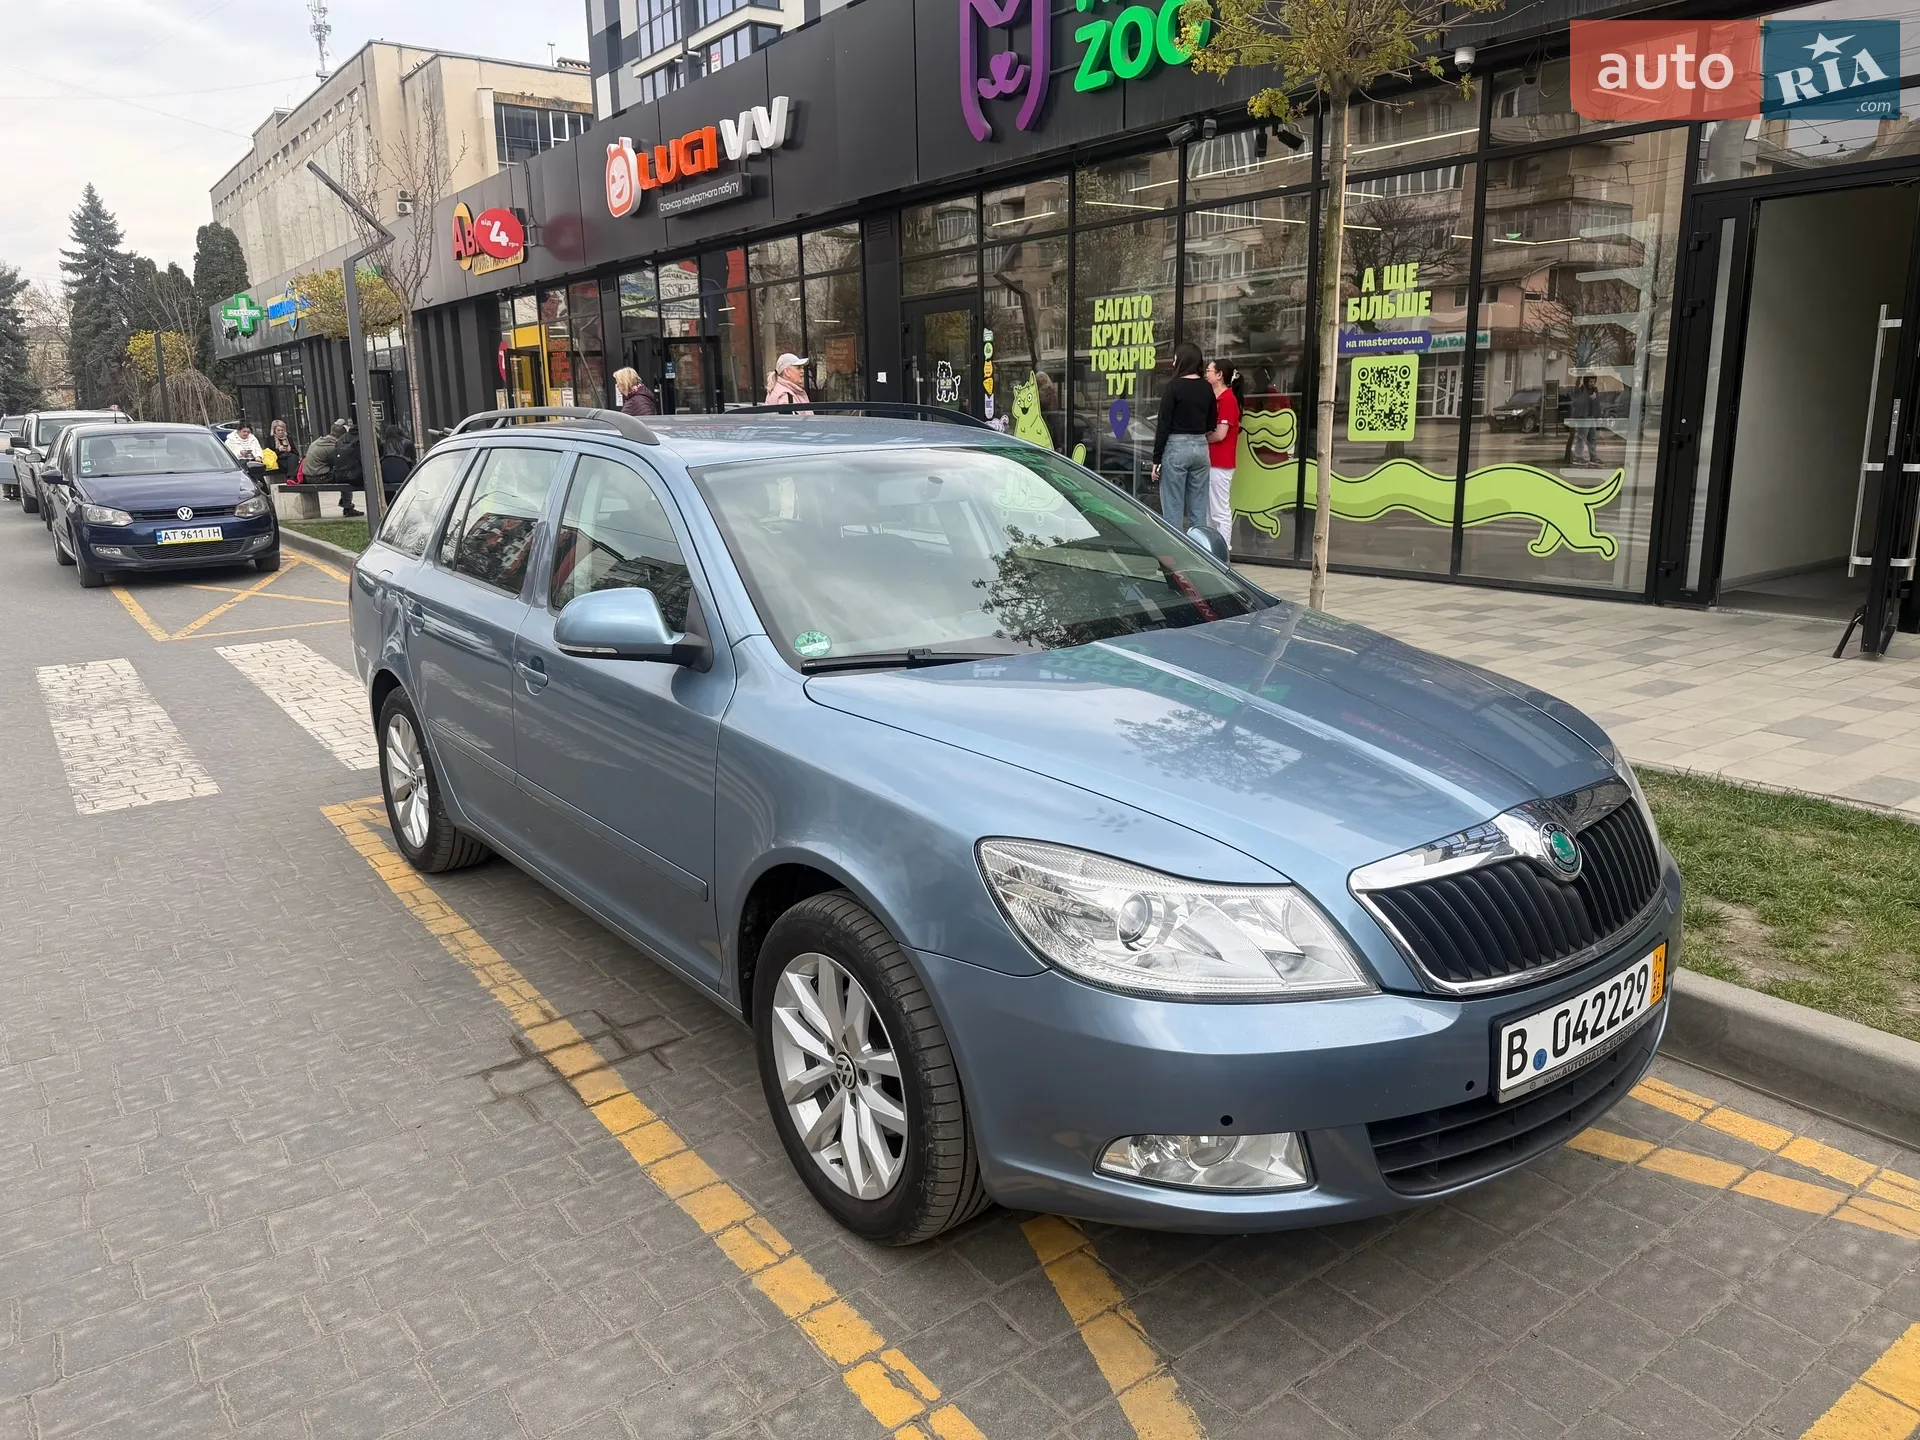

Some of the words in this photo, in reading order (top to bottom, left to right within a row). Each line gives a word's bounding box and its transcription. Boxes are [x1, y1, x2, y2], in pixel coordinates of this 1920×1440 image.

[637, 126, 718, 190] LUGI
[660, 200, 682, 212] Спонсор
[682, 188, 718, 205] комфортного
[718, 181, 739, 195] побуту
[489, 220, 510, 247] 4
[1361, 267, 1376, 293] А
[1382, 262, 1420, 291] ЩЕ
[1094, 294, 1153, 323] БАГАТО
[1347, 290, 1432, 322] БІЛЬШЕ
[1091, 320, 1155, 348] КРУТИХ
[1358, 335, 1424, 348] masterzoo.ua
[1088, 346, 1156, 372] ТОВАРІВ
[1105, 372, 1137, 396] ТУТ
[164, 531, 177, 541] AT
[180, 529, 204, 540] 9611
[207, 528, 221, 538] IH
[1506, 1027, 1528, 1080] B
[1552, 963, 1649, 1059] 042229
